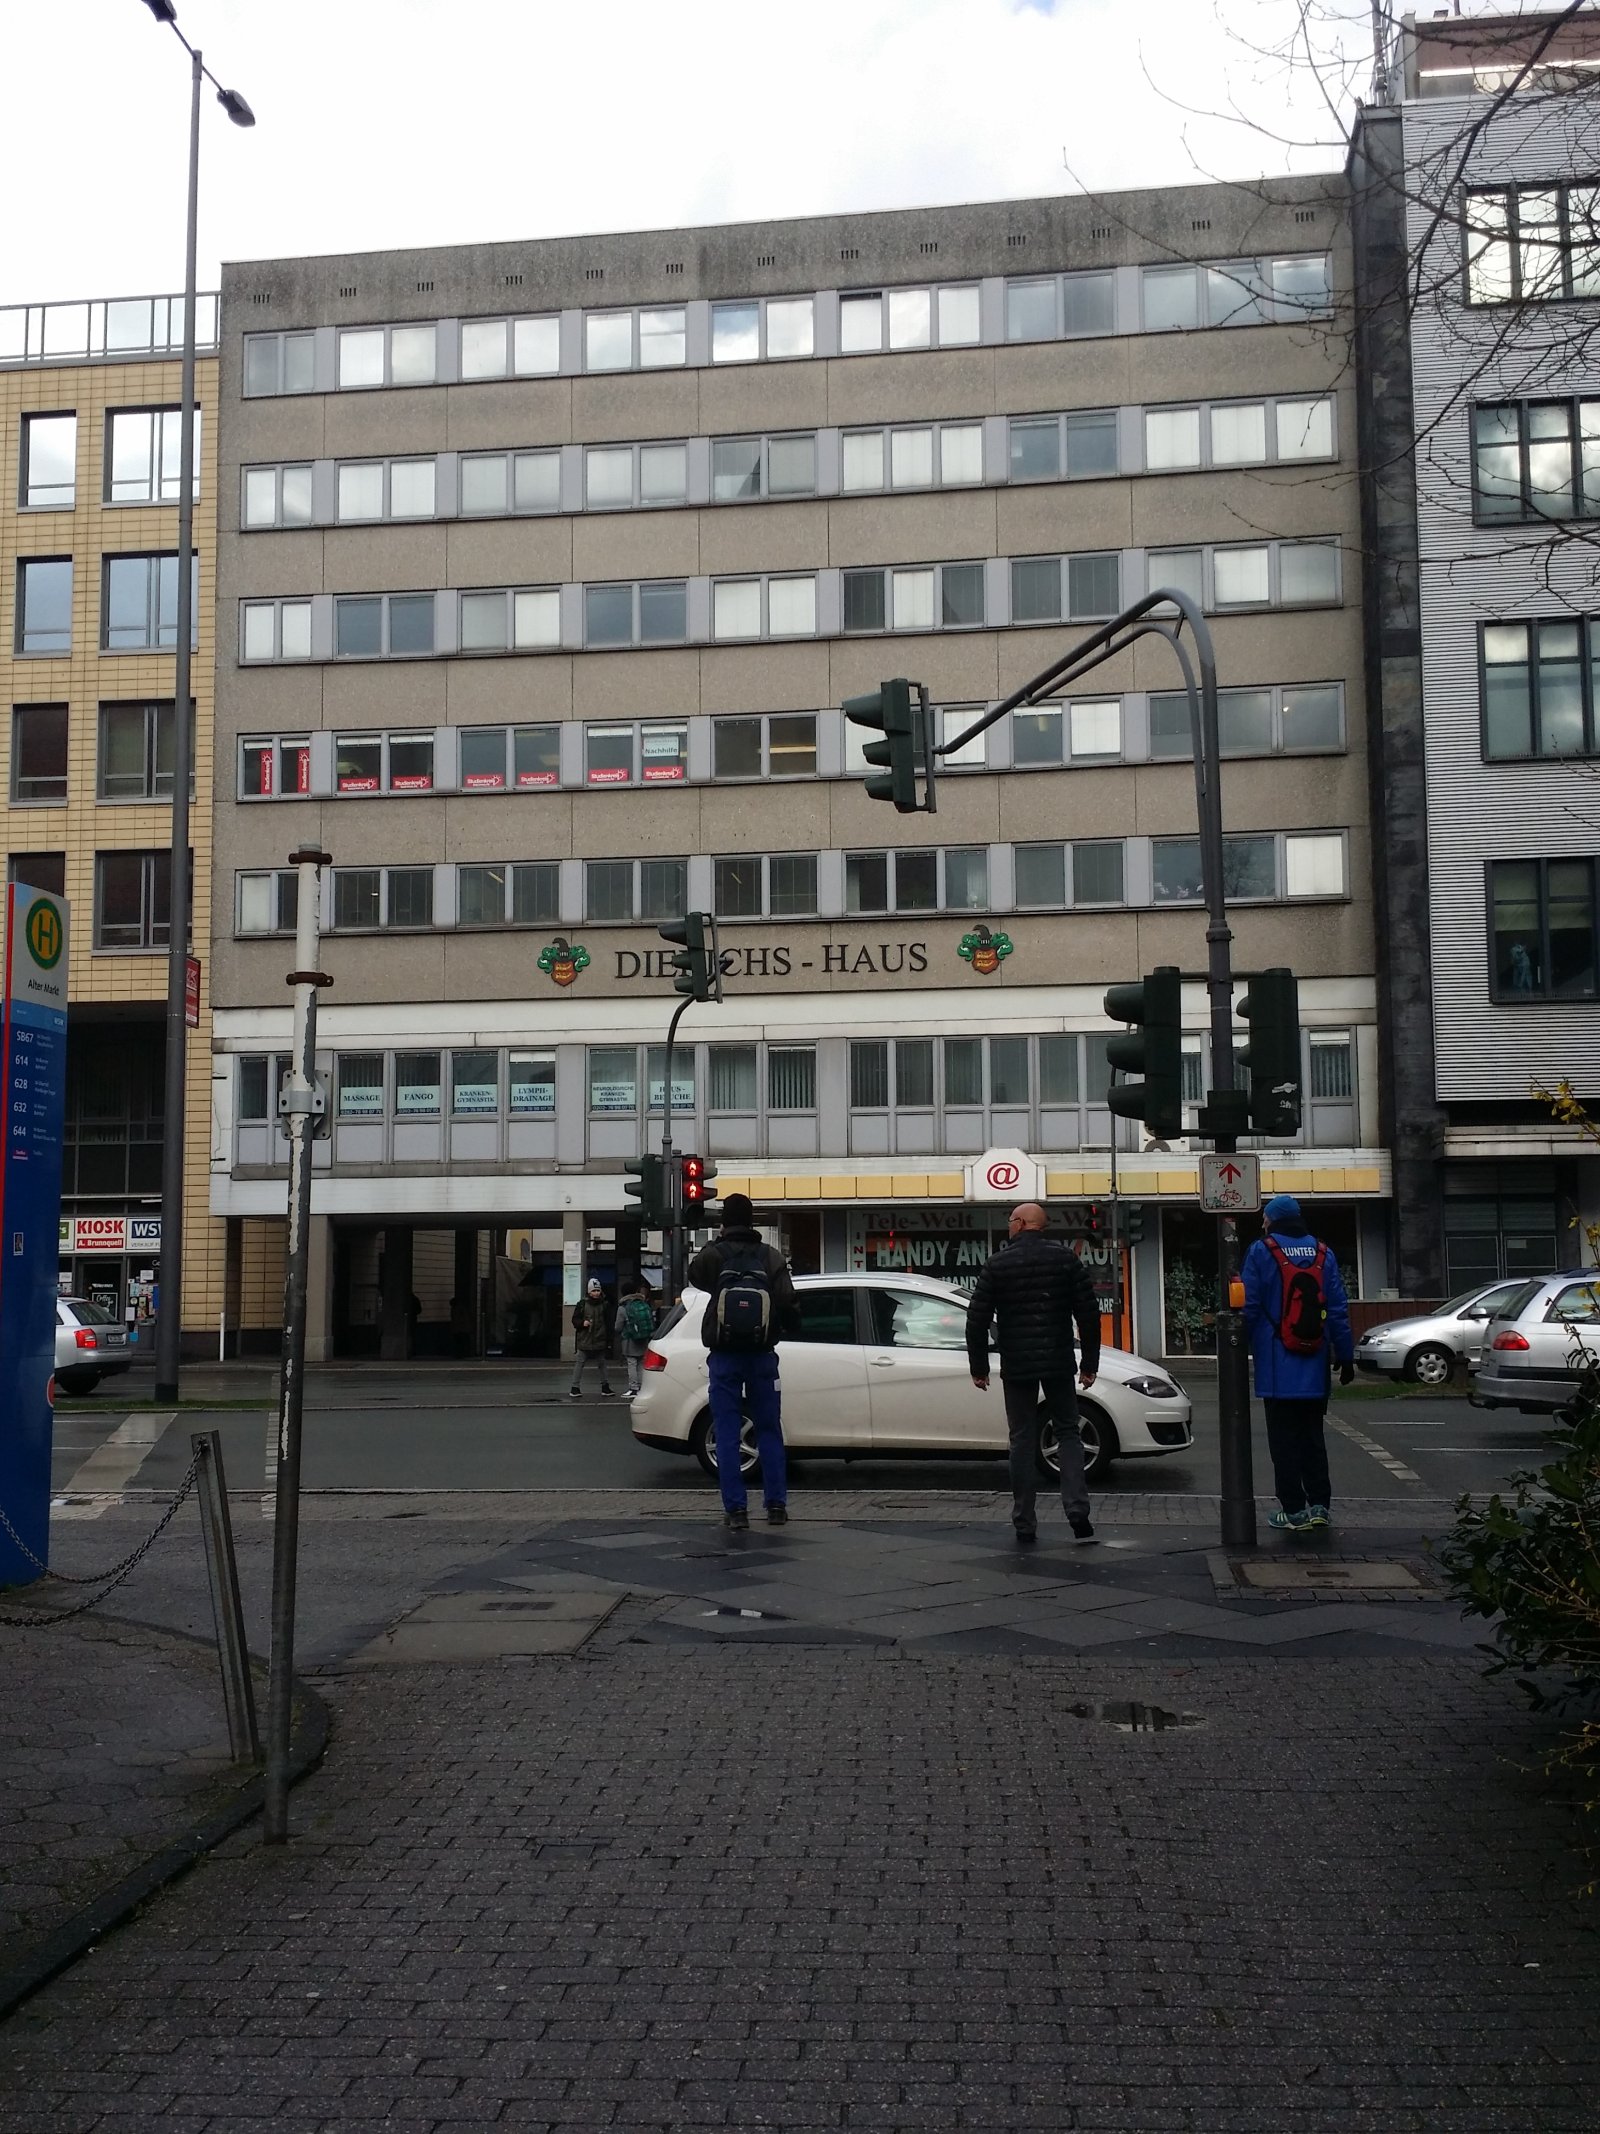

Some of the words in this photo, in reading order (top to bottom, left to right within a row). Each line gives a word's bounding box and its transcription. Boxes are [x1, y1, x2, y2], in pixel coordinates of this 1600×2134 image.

[614, 947, 791, 979] DIEICHS
[821, 943, 929, 974] HAUS
[27, 979, 43, 991] Alter
[44, 983, 60, 996] Markt
[16, 1030, 34, 1043] SB67
[15, 1054, 29, 1066] 614
[14, 1078, 28, 1089] 628
[343, 1094, 380, 1102] MASSAGE
[404, 1093, 434, 1101] FANGO
[654, 1093, 691, 1101] BECHE
[13, 1101, 27, 1113] 632
[13, 1125, 27, 1137] 644
[987, 1162, 1020, 1190] @
[77, 1220, 124, 1234] KIOSK
[862, 1212, 974, 1230] Tele-Welt
[134, 1223, 161, 1237] WS
[876, 1240, 951, 1267] HANDY
[1281, 1246, 1317, 1257] LUNTEE
